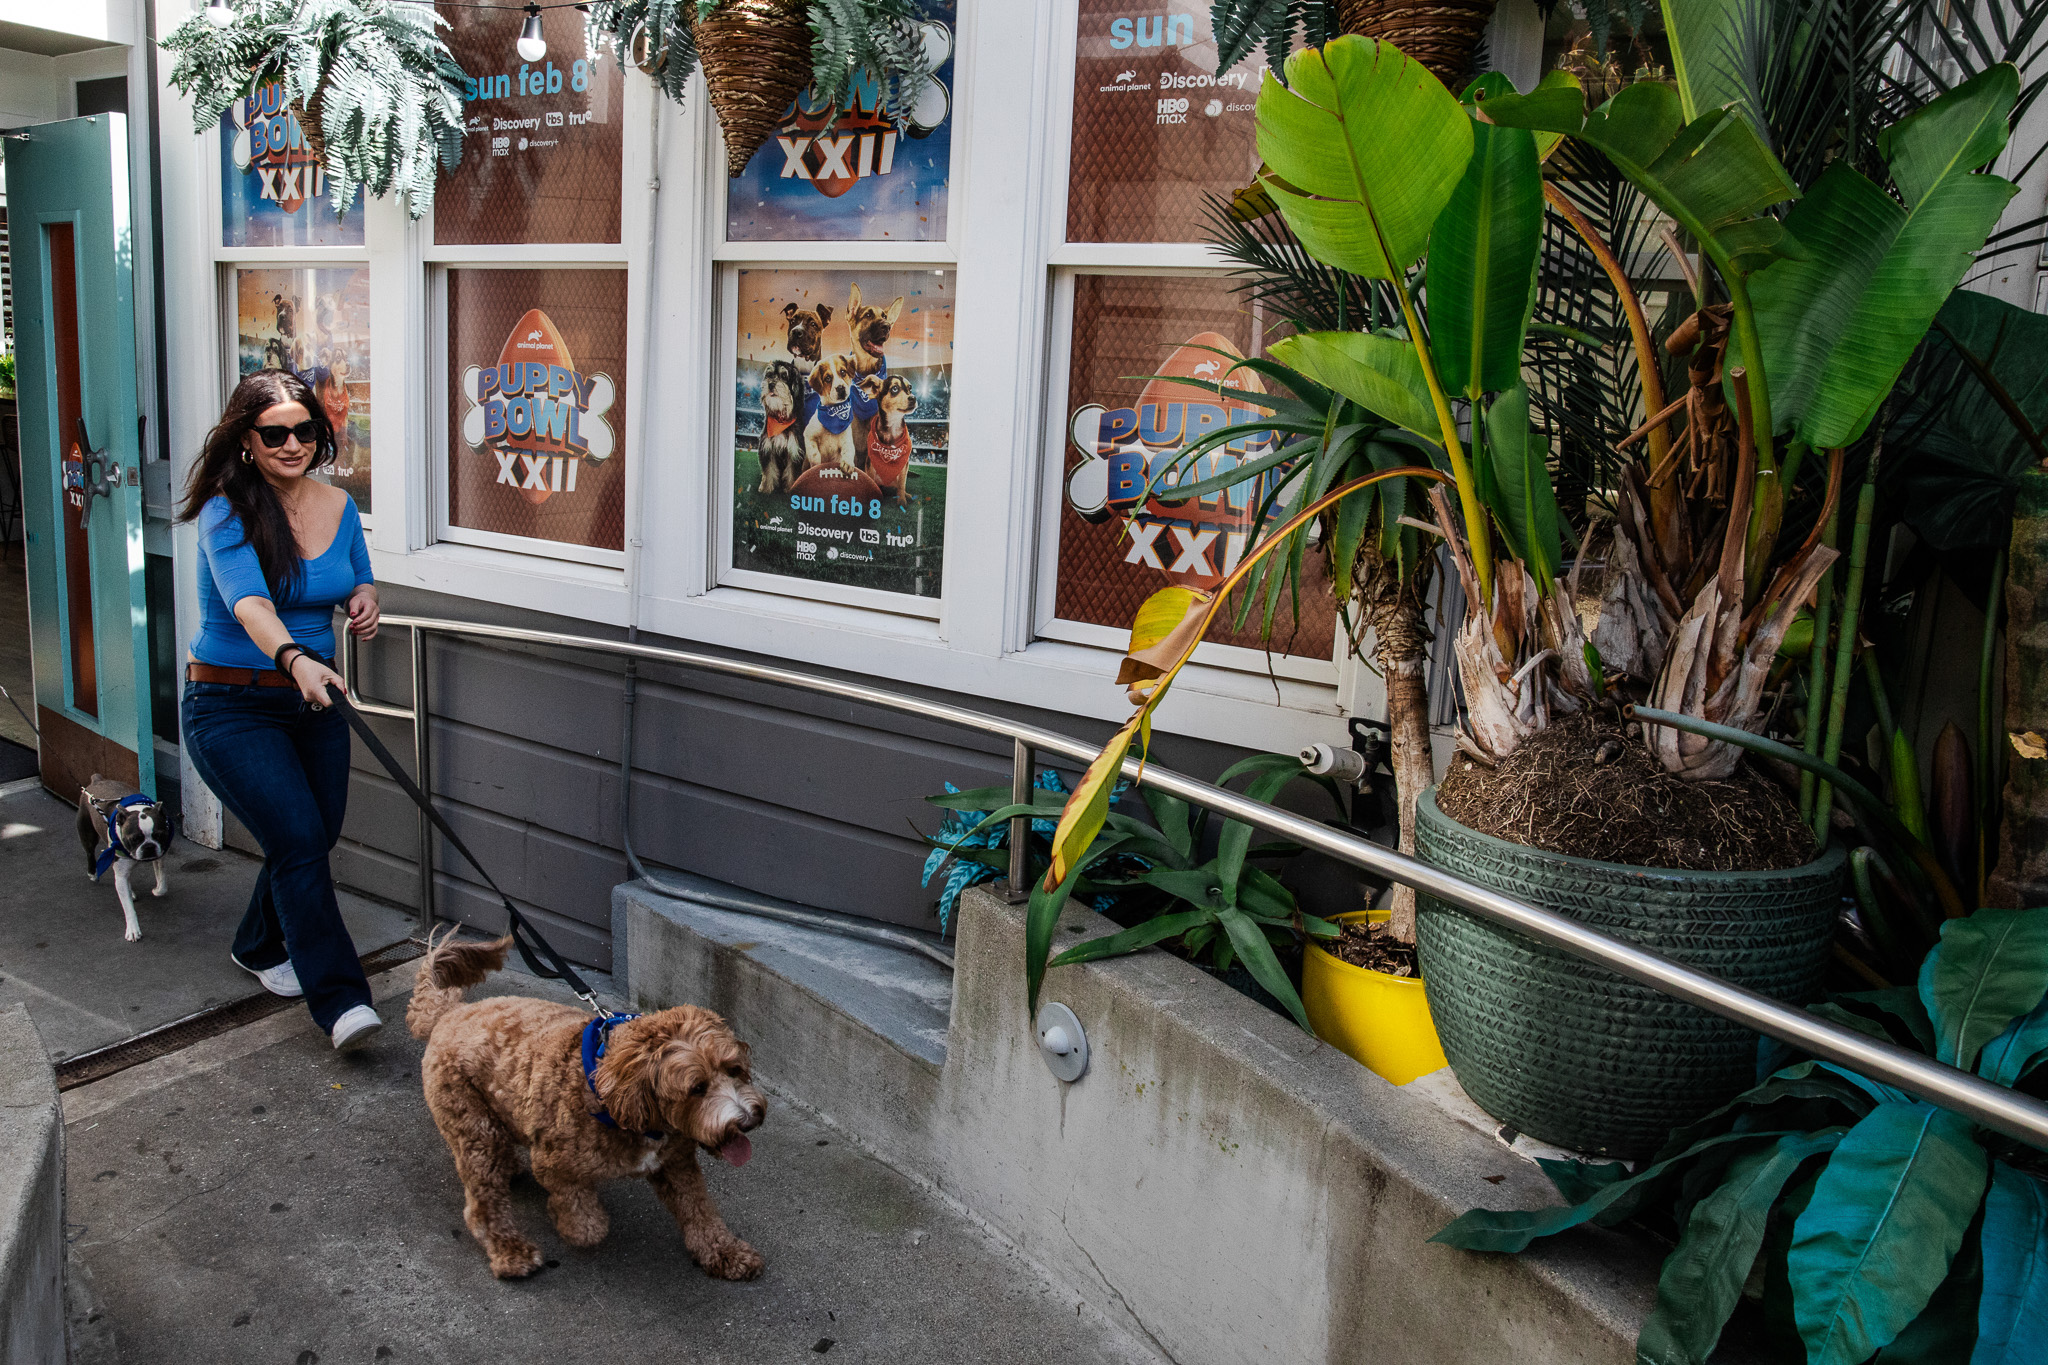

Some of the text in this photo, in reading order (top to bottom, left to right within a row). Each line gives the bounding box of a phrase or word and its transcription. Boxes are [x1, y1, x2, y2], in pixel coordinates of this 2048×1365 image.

[1109, 13, 1194, 50] sun
[465, 59, 588, 101] sun feb 8
[1100, 83, 1151, 92] animal planet
[1159, 72, 1248, 90] Discovery
[1157, 98, 1190, 114] HBO
[1226, 102, 1257, 112] discov
[493, 117, 541, 131] Discovery
[1157, 113, 1187, 125] max
[492, 137, 510, 149] HBO
[492, 148, 509, 157] max
[776, 130, 898, 180] XXII
[257, 165, 325, 201] XXII
[517, 341, 554, 350] animal planet
[477, 362, 597, 412] PUPPY
[484, 396, 589, 451] BOWL
[493, 448, 579, 492] XXII
[790, 494, 881, 519] sun feb 8
[759, 524, 793, 533] animal planet
[797, 521, 854, 543] Discovery
[860, 529, 879, 544] tbs
[796, 540, 817, 553] HBO
[796, 551, 816, 562] max
